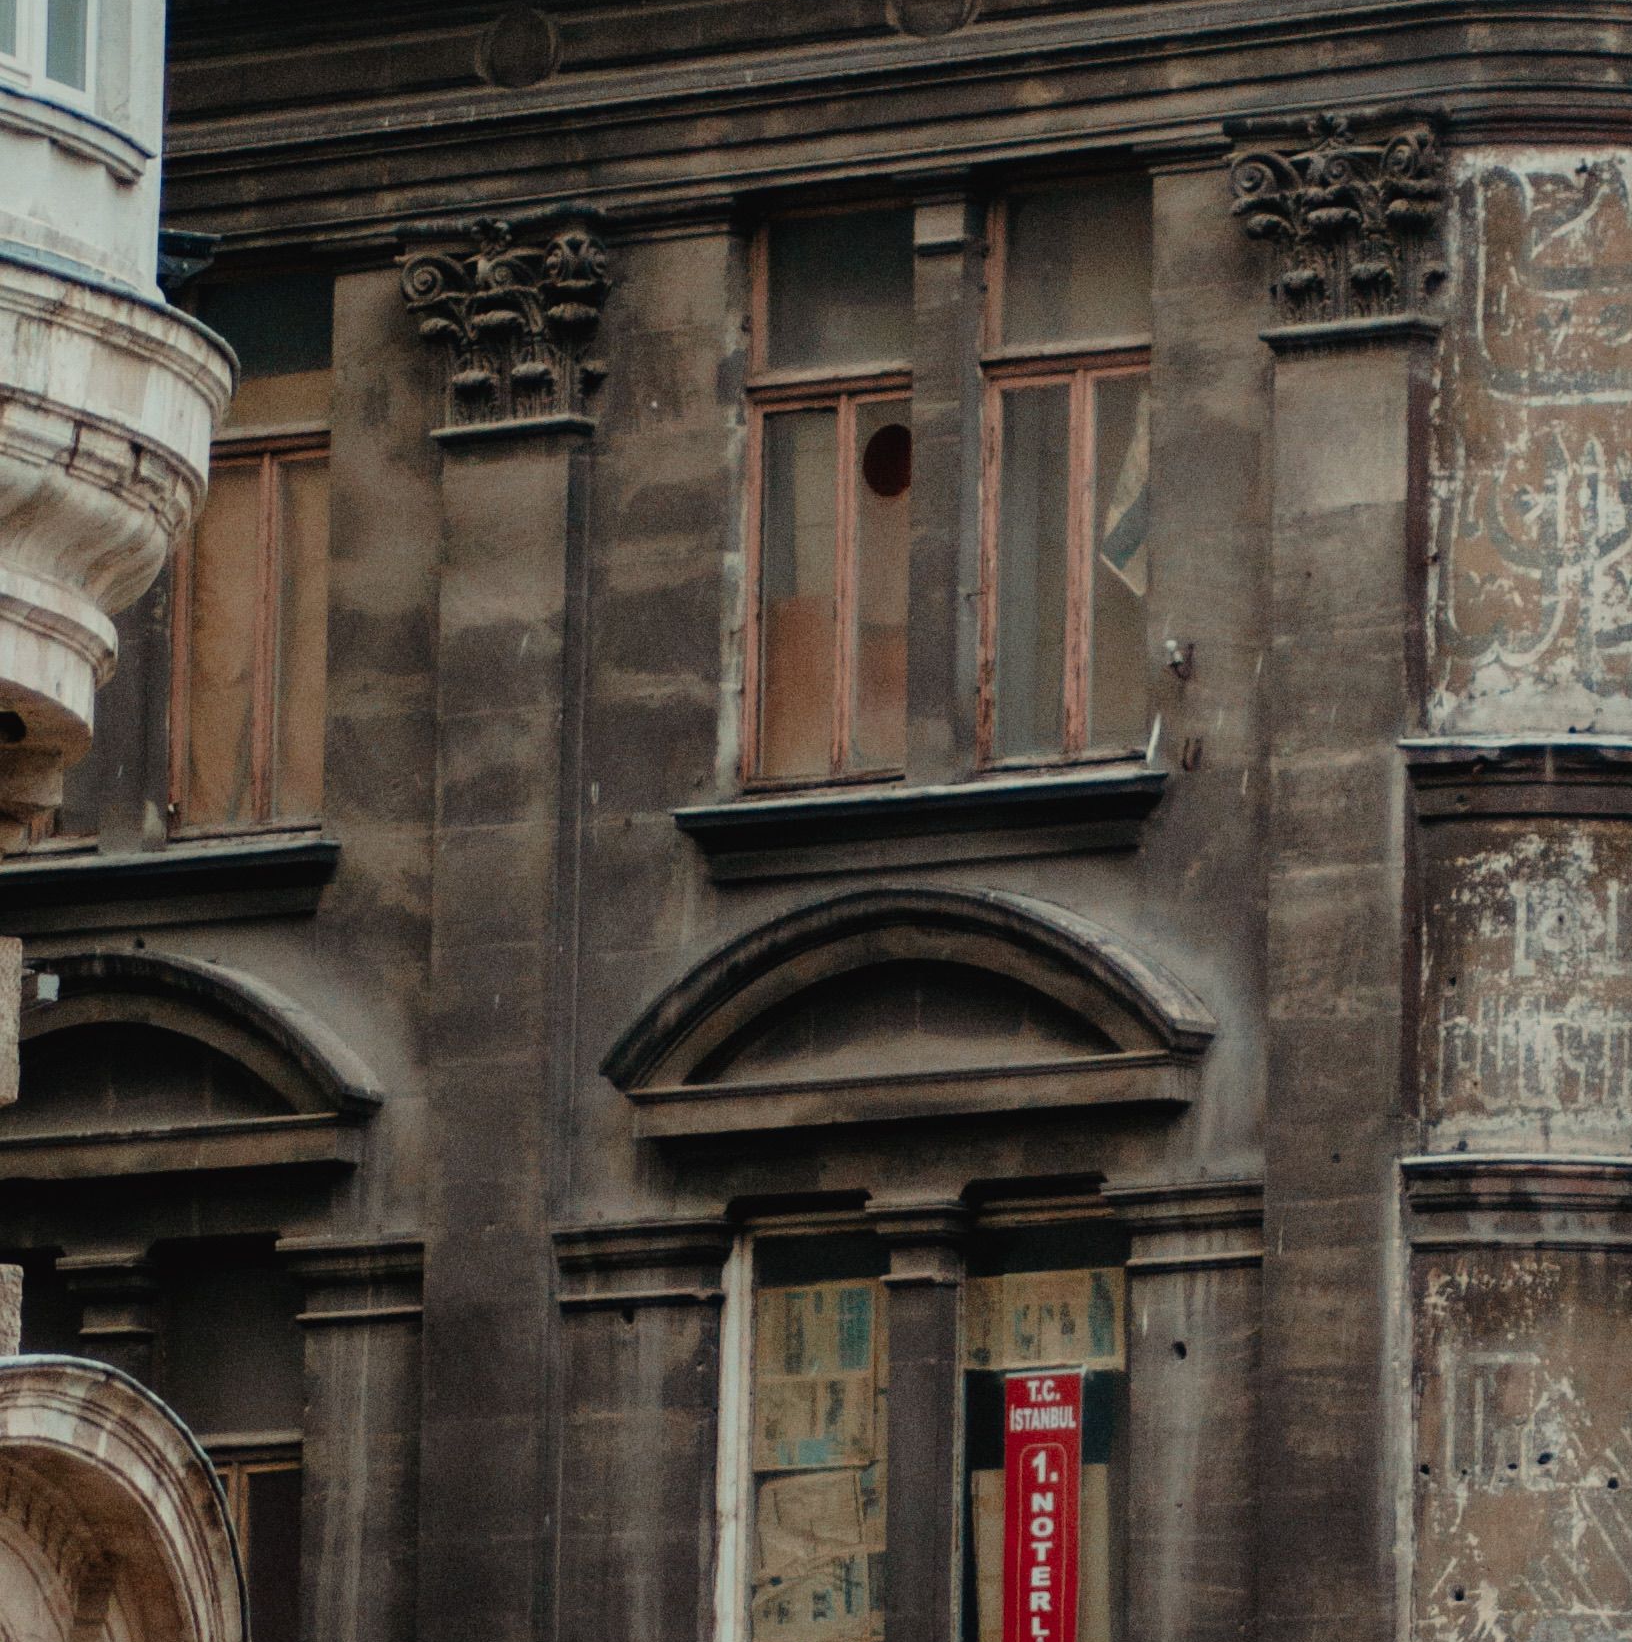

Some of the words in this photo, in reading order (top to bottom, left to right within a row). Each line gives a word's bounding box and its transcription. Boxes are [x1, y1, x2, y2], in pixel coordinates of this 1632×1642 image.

[1026, 1379, 1062, 1402] T.C.
[1010, 1404, 1077, 1431] İSTANBUL
[1031, 1451, 1059, 1483] 1.
